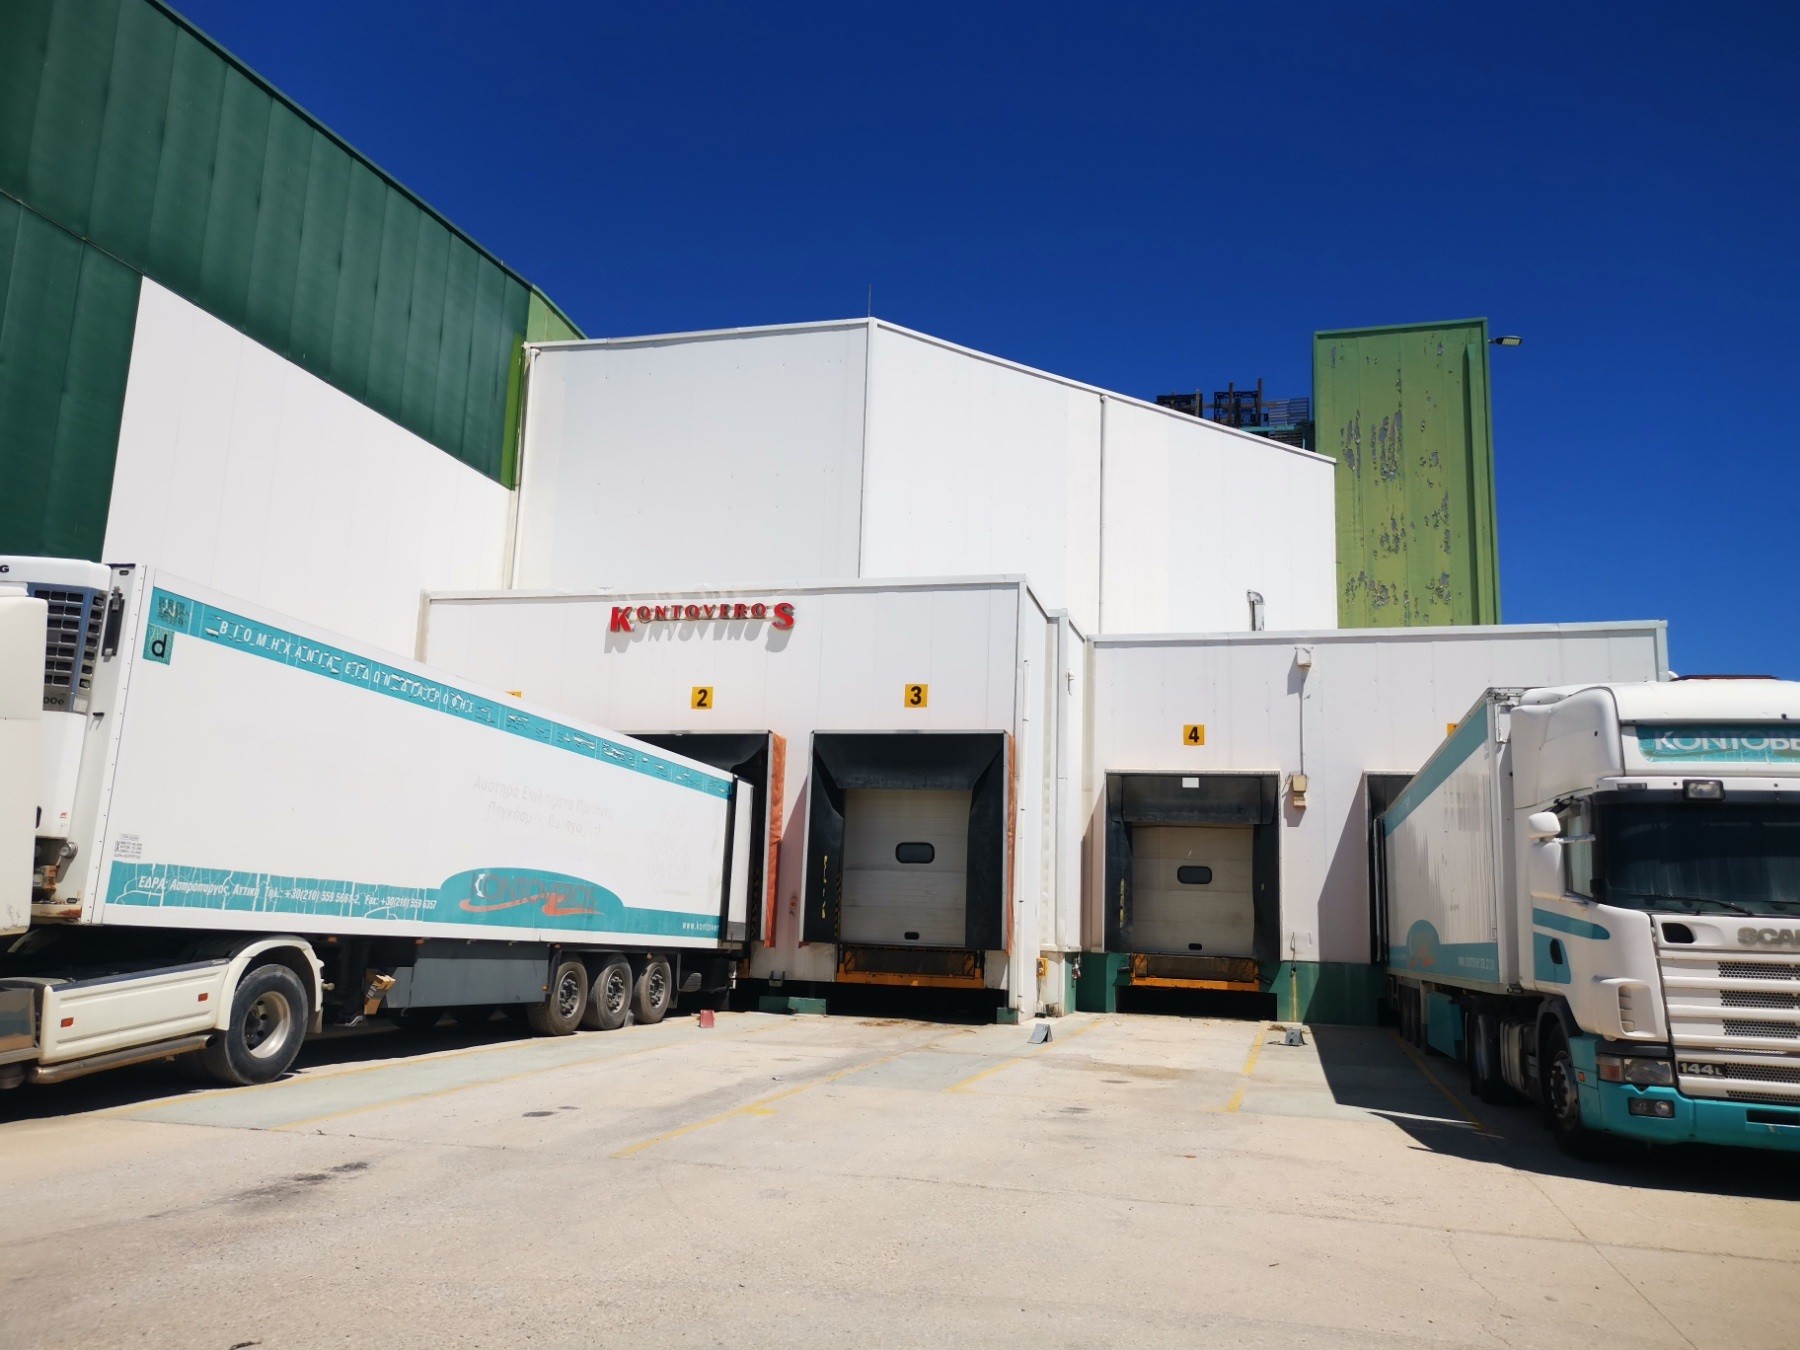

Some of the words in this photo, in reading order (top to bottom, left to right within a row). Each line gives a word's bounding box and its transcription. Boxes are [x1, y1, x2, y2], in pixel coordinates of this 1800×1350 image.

[609, 602, 795, 632] KONTOVEROS
[696, 688, 708, 707] 2
[909, 685, 923, 706] 3
[1187, 726, 1200, 743] 4
[1737, 926, 1800, 946] SCA
